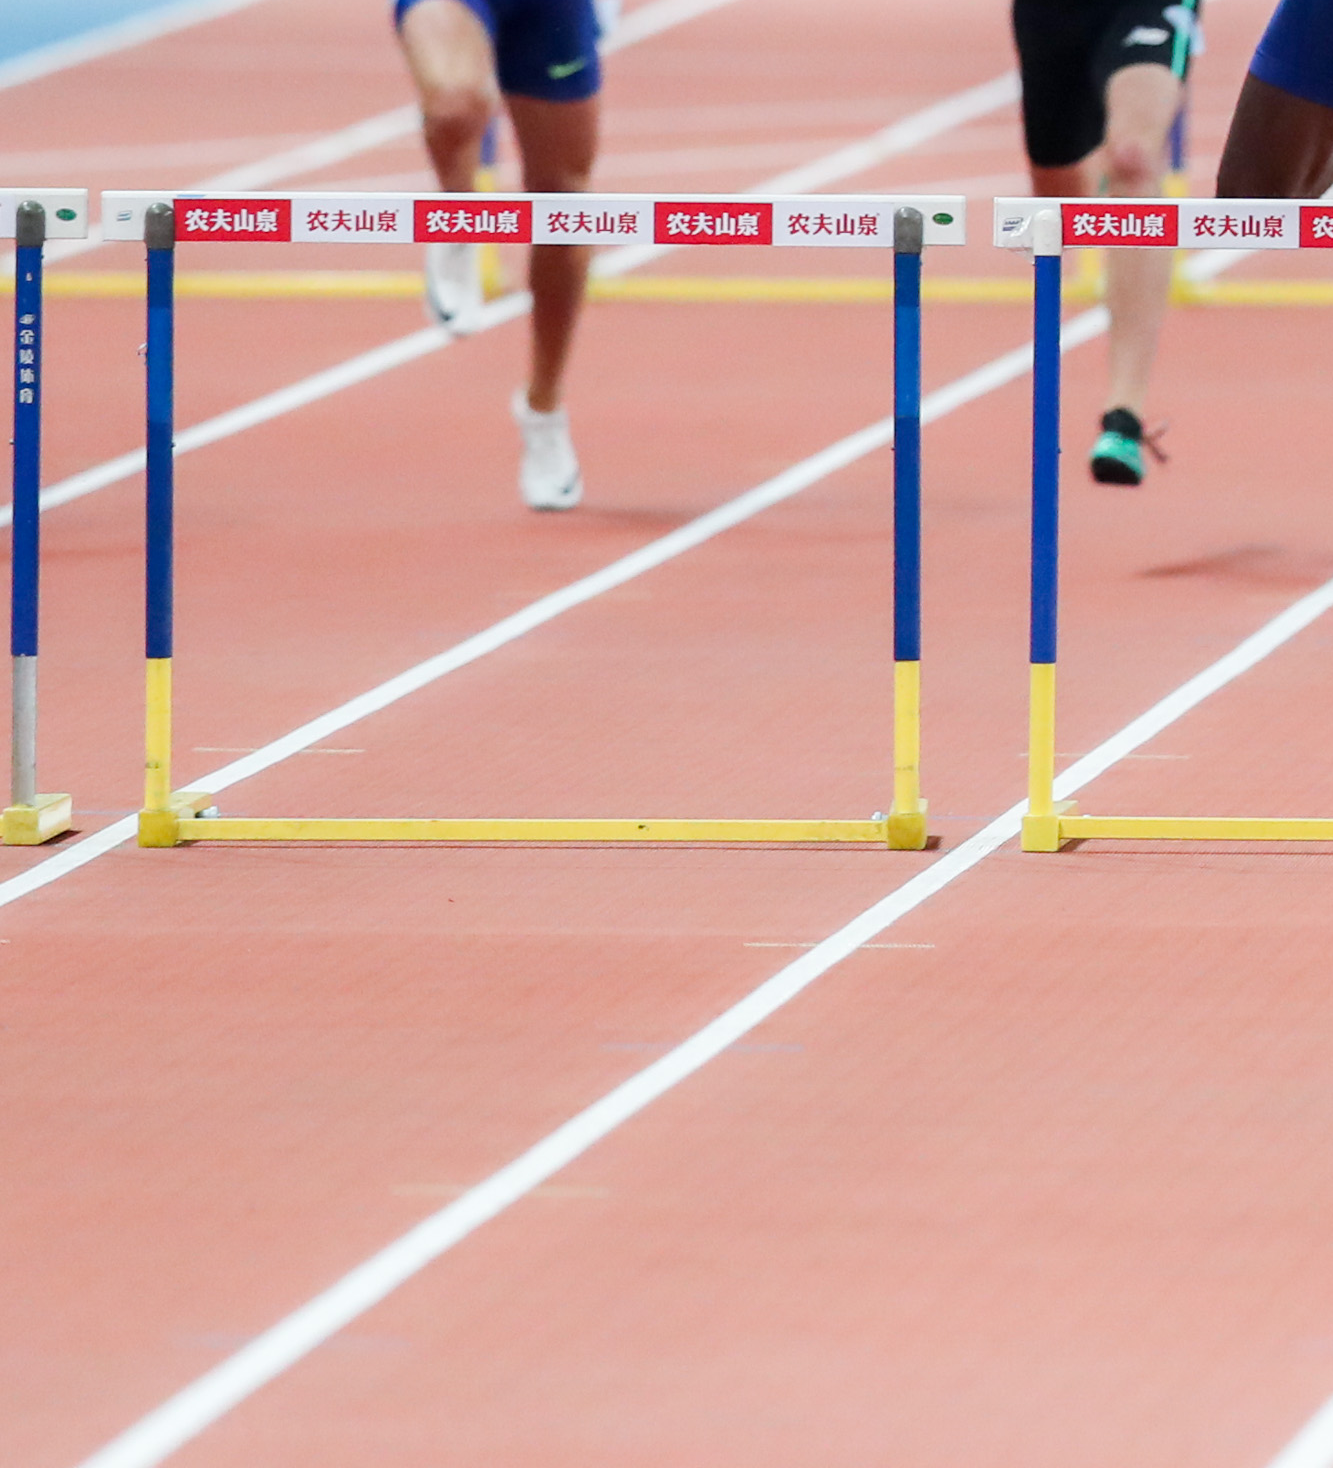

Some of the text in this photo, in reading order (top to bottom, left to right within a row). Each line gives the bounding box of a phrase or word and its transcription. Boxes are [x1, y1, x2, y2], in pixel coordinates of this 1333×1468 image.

[186, 208, 878, 237] 农夫山泉 农夫山泉 农夫山泉 农夫山泉 农夫山泉 农夫山泉
[1073, 213, 1165, 237] 农夫山泉
[1194, 215, 1283, 237] 农夫山泉
